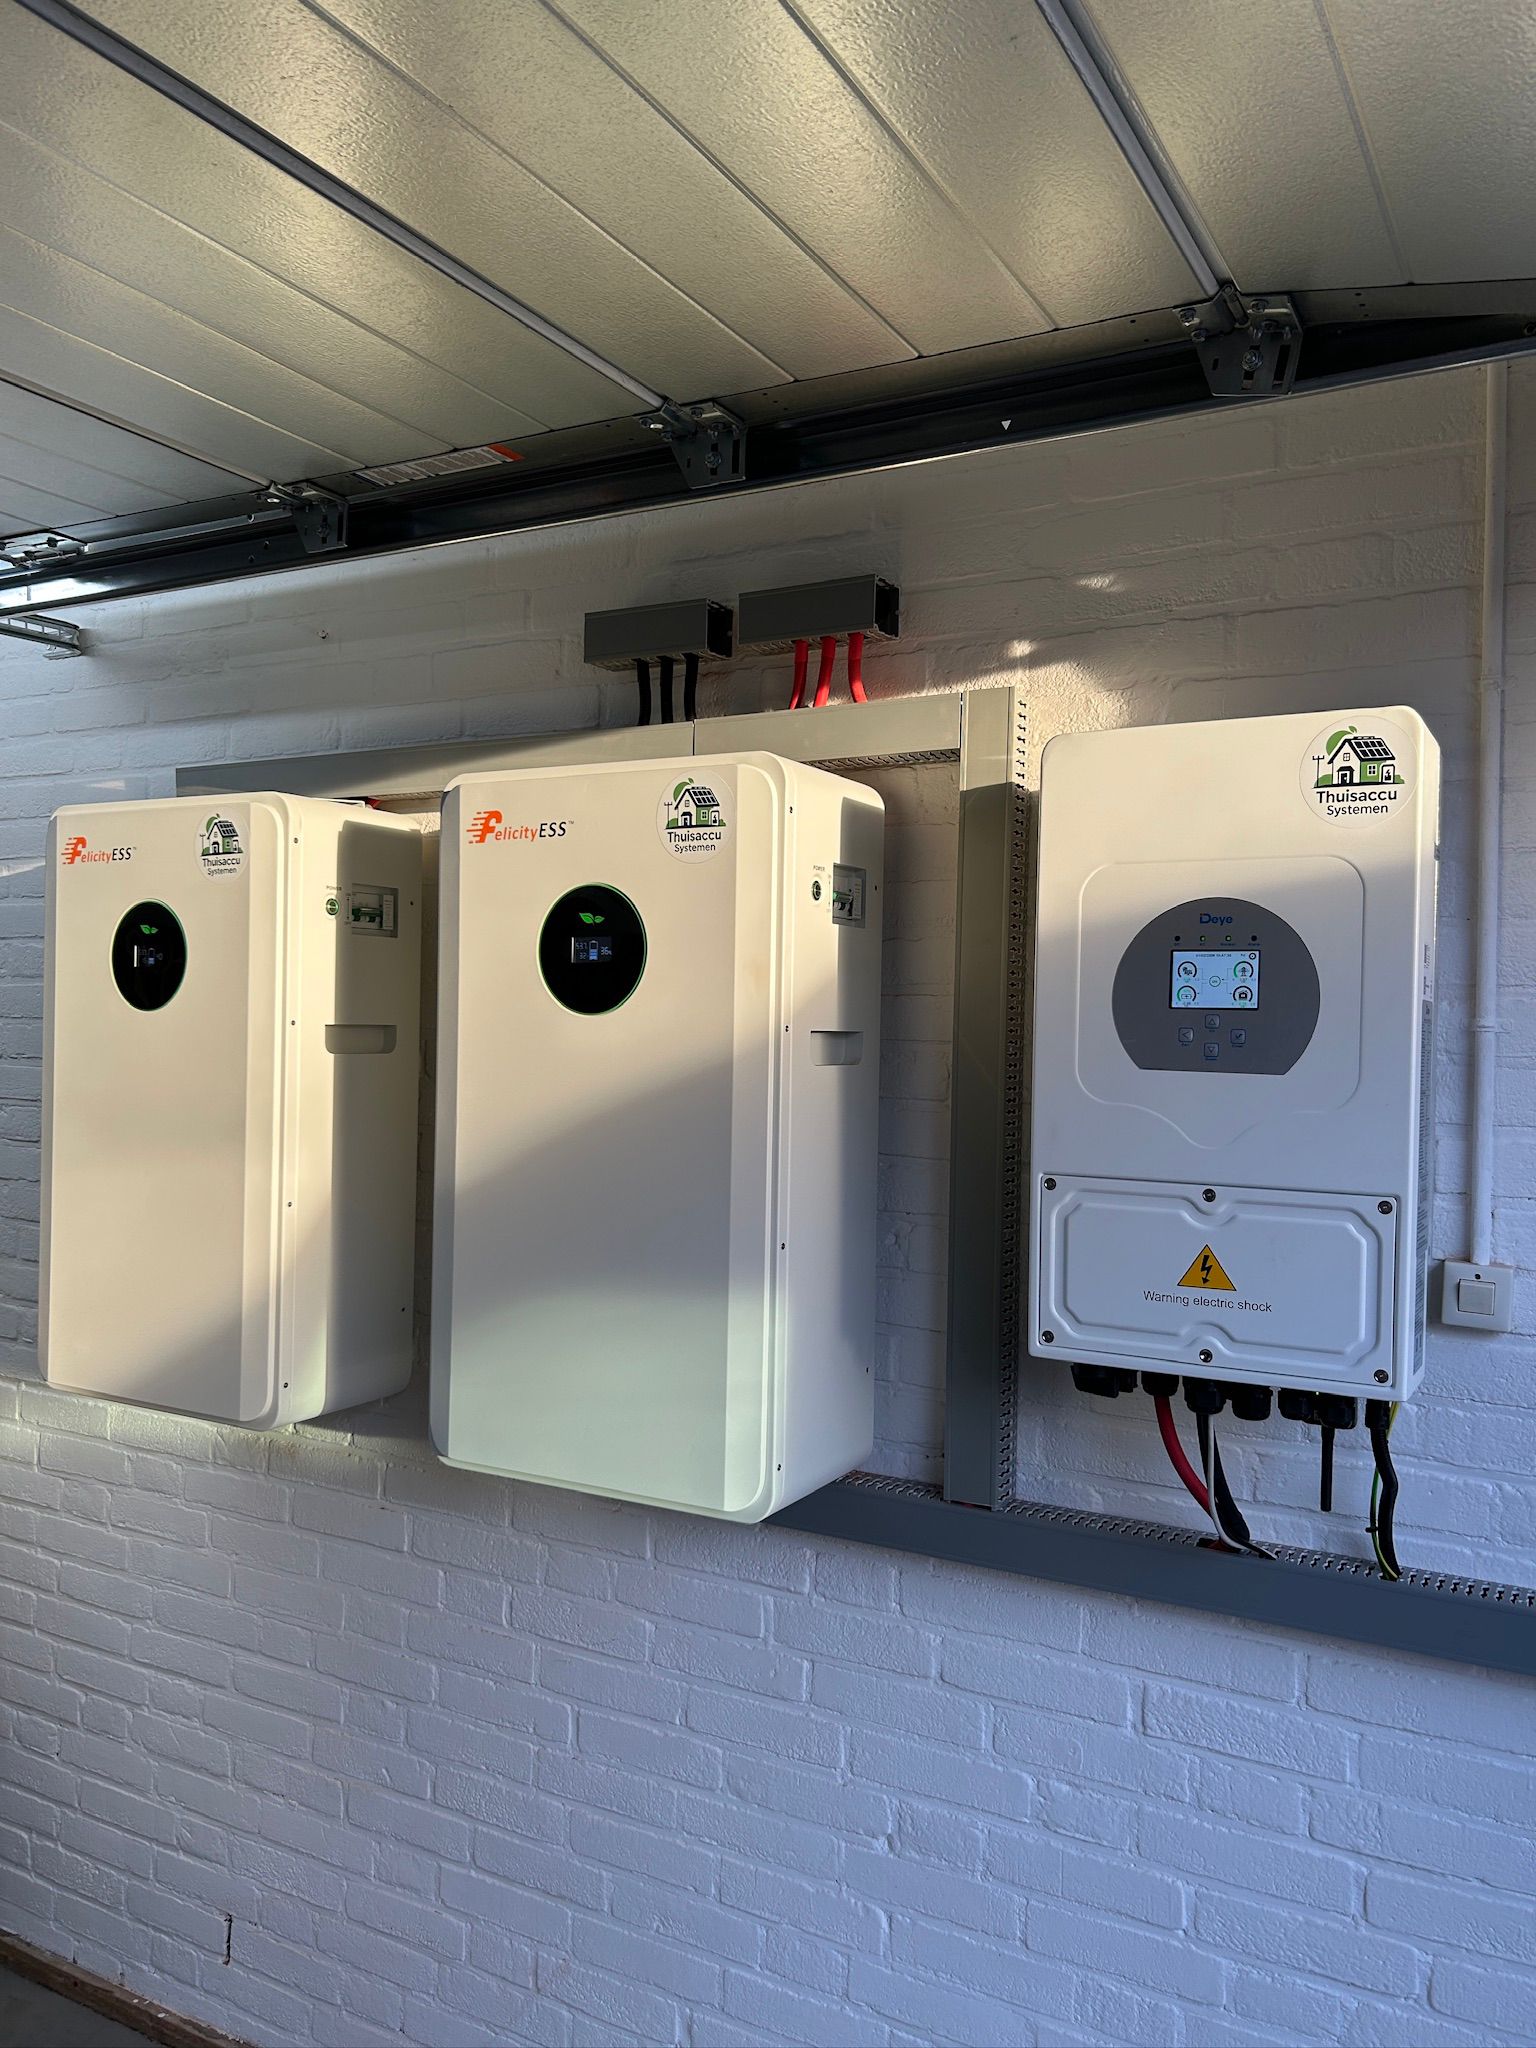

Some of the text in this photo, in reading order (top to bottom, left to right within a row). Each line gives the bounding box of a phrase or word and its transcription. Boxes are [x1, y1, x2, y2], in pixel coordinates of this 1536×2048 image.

[1316, 789, 1397, 803] Thuisaccu
[1327, 804, 1388, 817] Systemen
[667, 830, 721, 843] Thuisaccu
[674, 843, 716, 854] Systemen
[202, 856, 241, 867] Thuisaccu
[207, 867, 238, 876] Systemen
[1199, 912, 1233, 926] Deye
[1143, 1290, 1273, 1313] Warning electric shock
